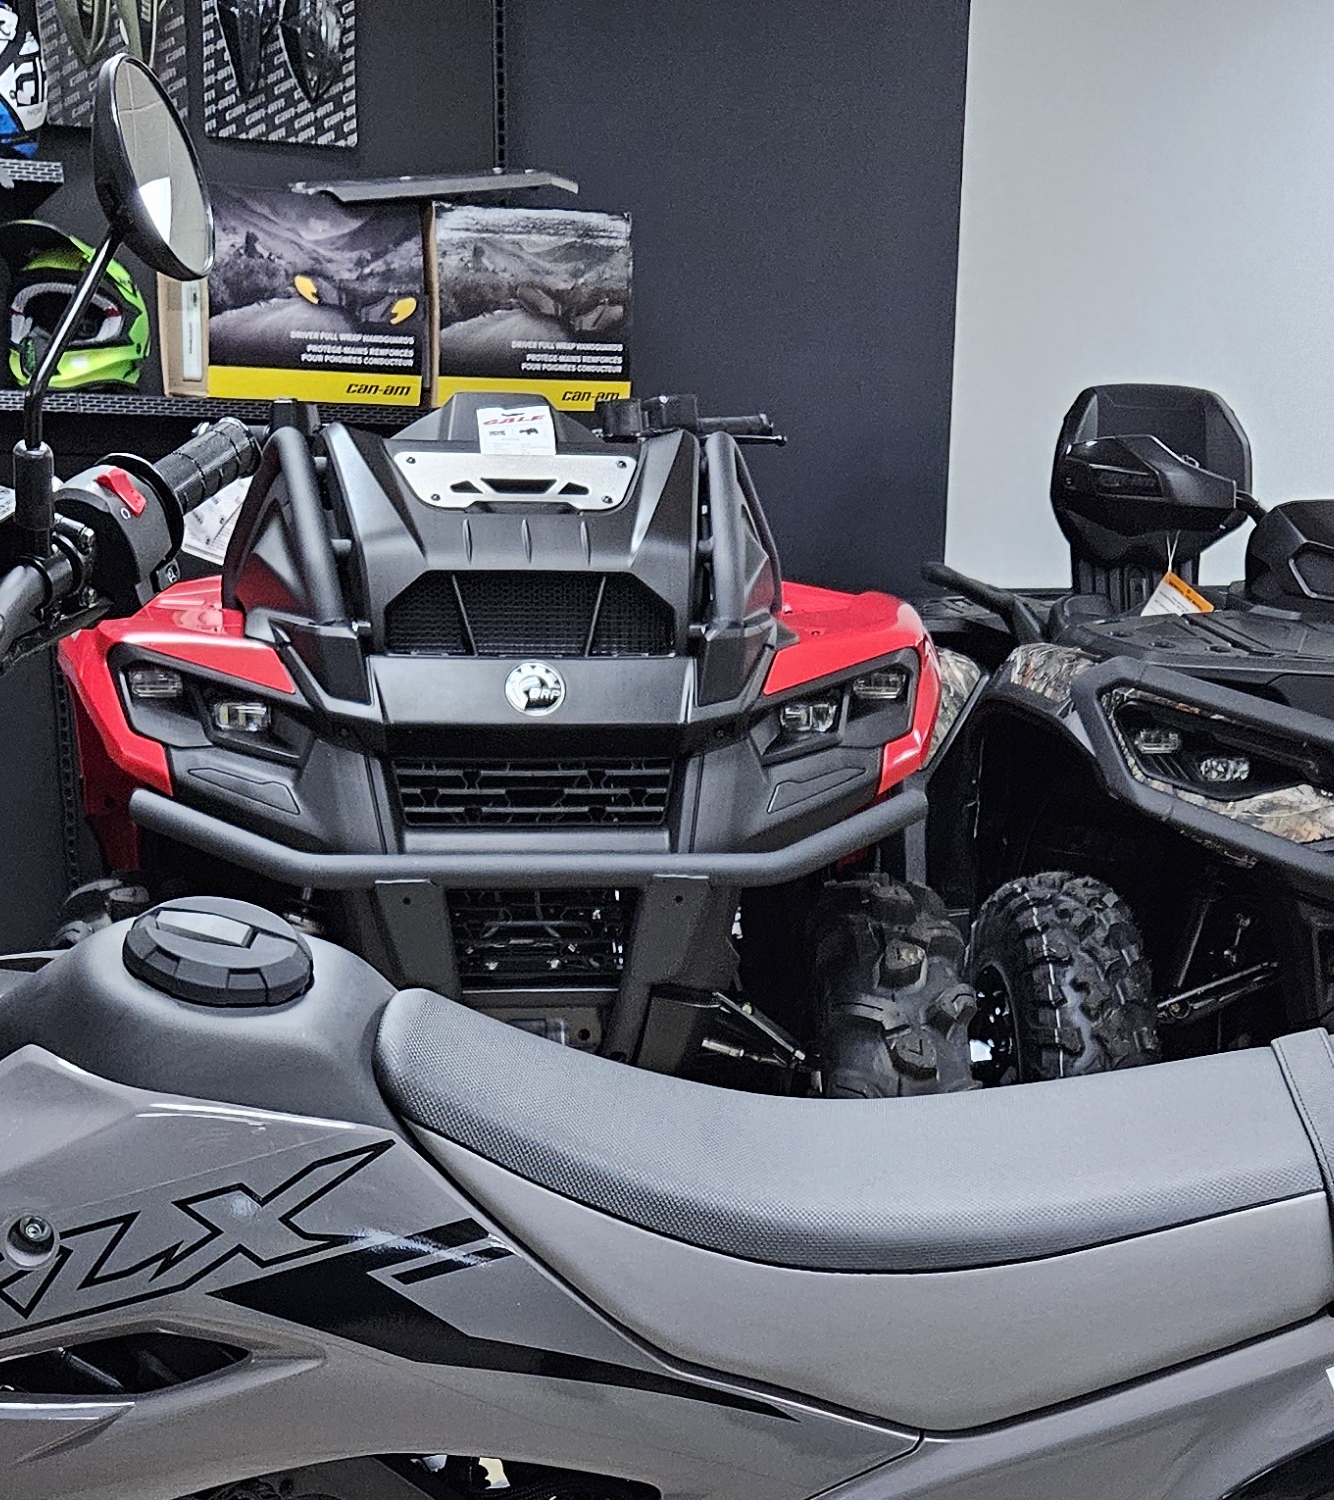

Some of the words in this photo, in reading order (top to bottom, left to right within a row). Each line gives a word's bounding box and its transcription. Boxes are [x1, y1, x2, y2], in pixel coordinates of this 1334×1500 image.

[290, 330, 320, 340] DRIVER
[320, 331, 338, 341] FULL
[338, 333, 363, 342] WRAP
[301, 353, 323, 364] POUR
[346, 383, 411, 396] can-am
[561, 391, 620, 401] can-am
[528, 687, 561, 700] BRP
